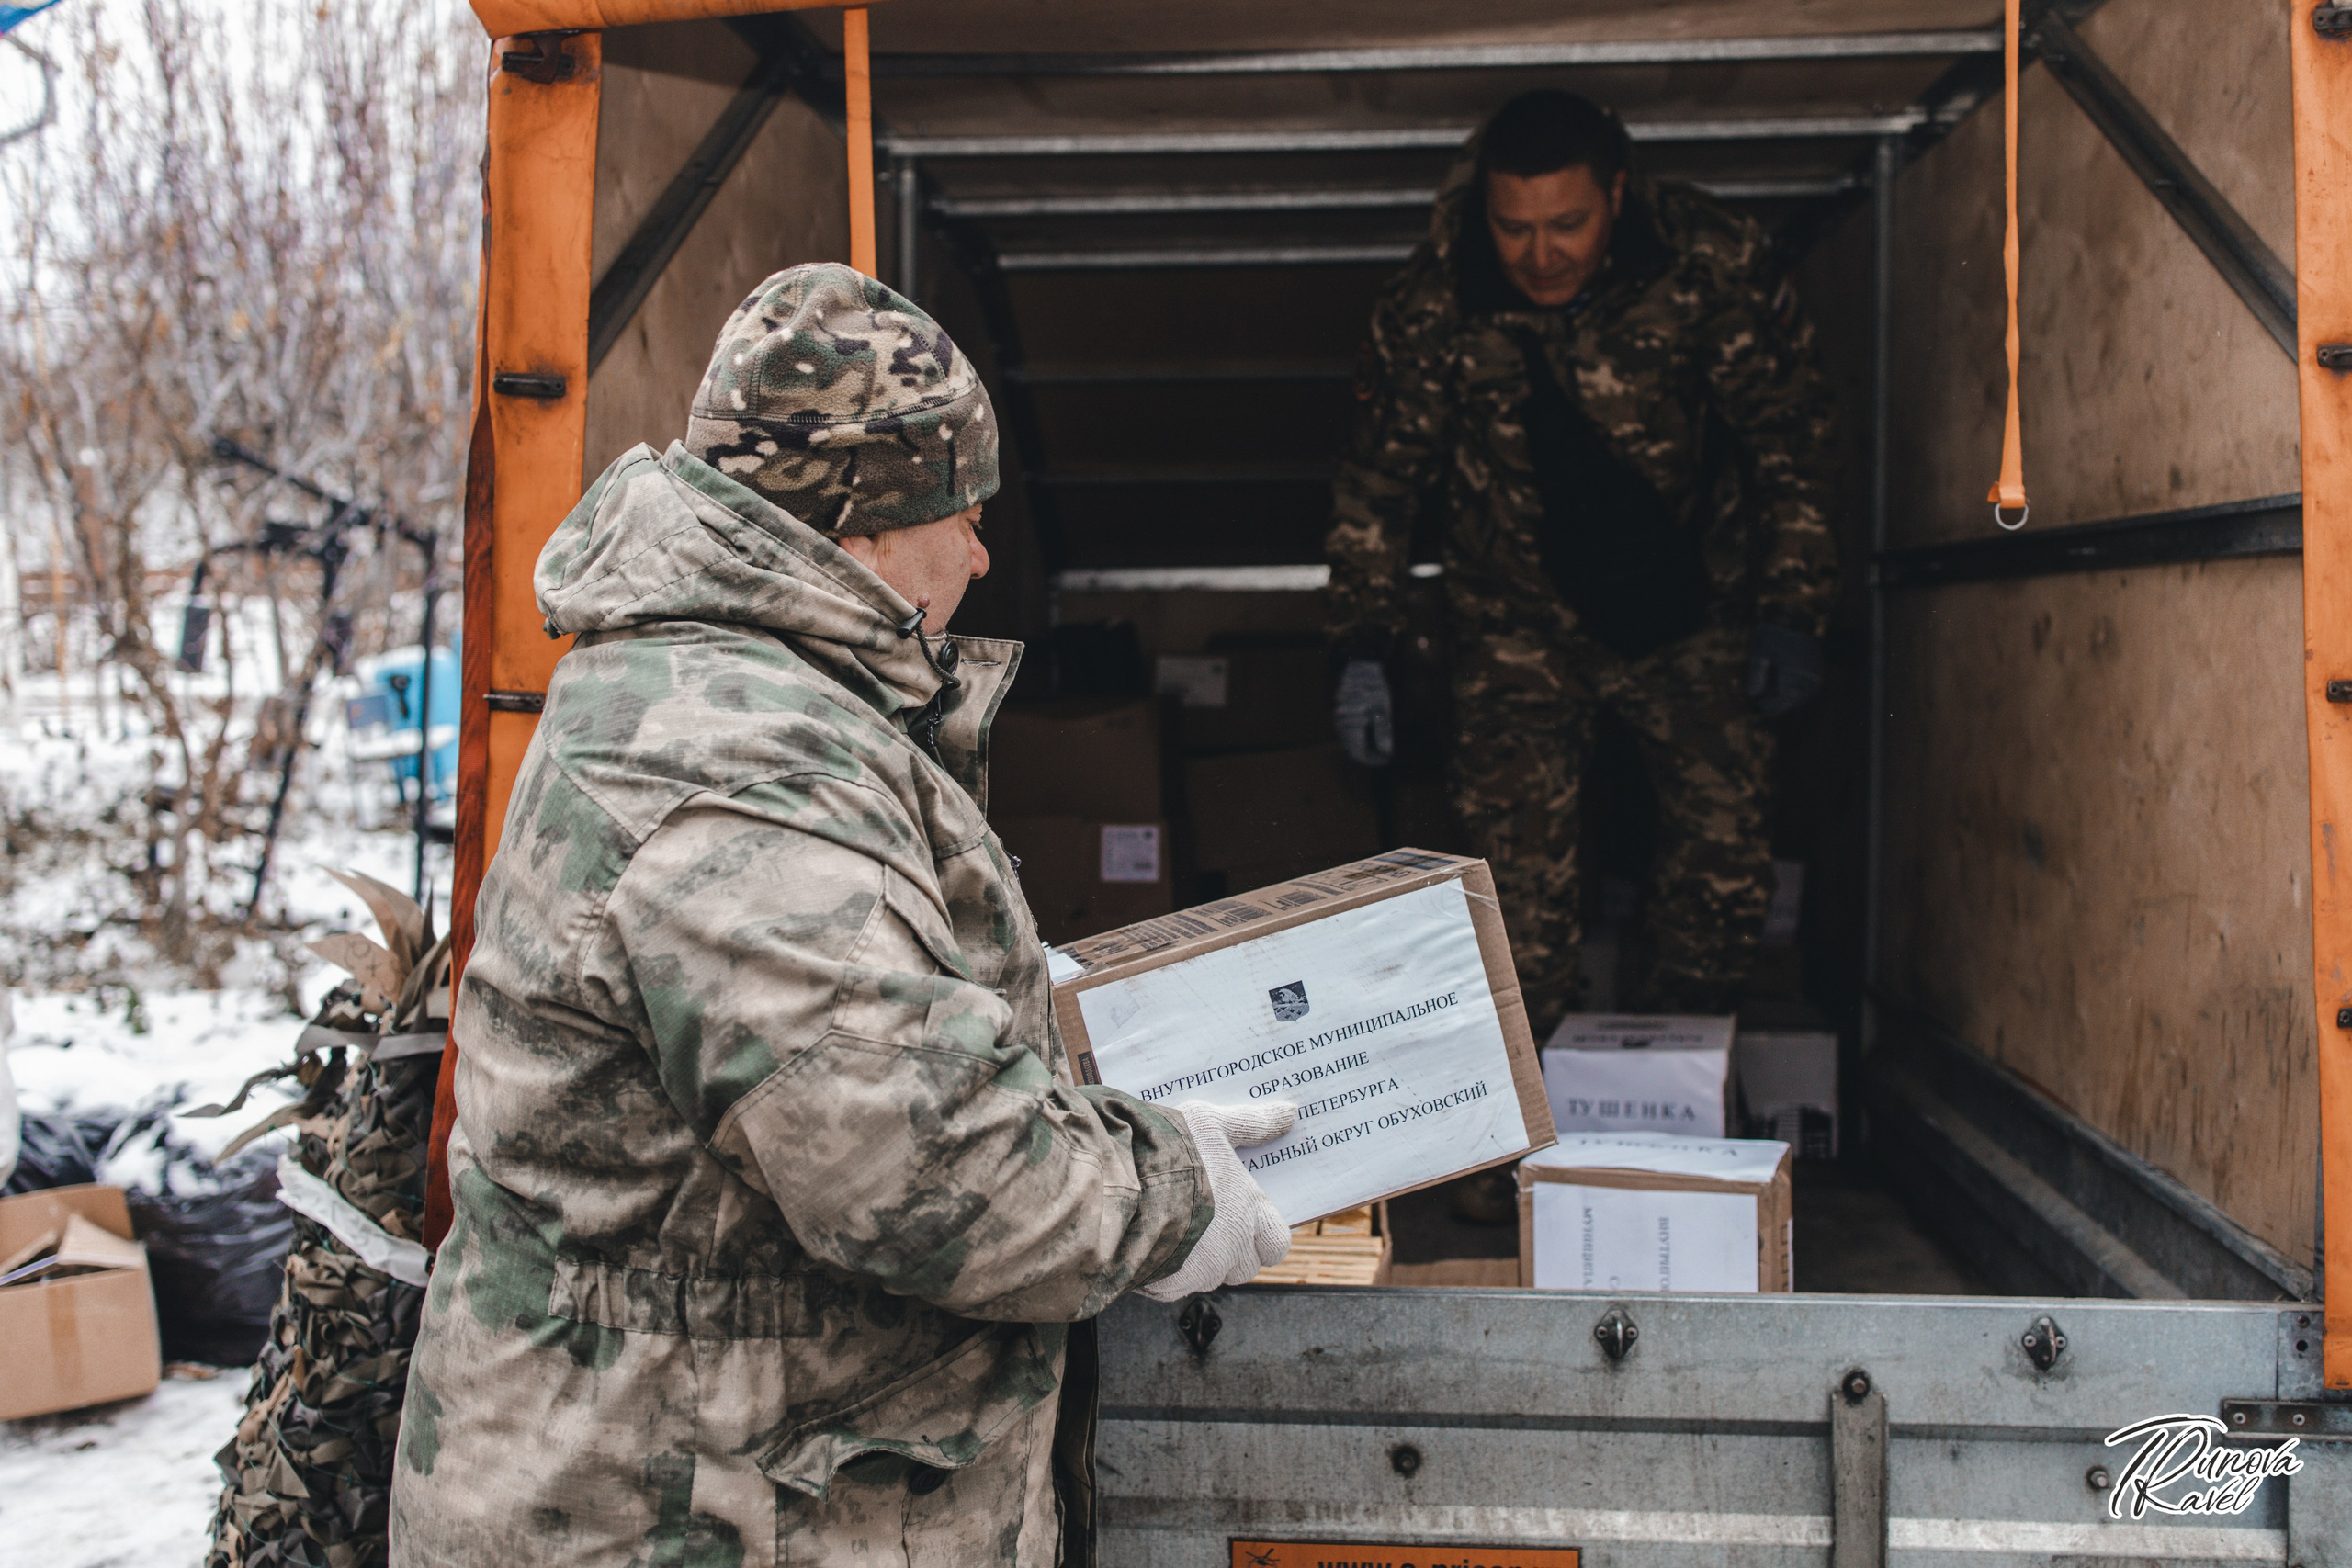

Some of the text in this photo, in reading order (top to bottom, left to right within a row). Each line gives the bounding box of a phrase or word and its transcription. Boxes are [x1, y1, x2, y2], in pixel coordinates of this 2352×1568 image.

[1140, 992, 1459, 1102] ВНУТРИГОРОДСКОЕ МУНИЦИПАЛЬНОЕ
[1250, 1051, 1370, 1099] ОБРАЗОВАНИЕ
[1242, 1080, 1487, 1173] АЛЬНЫЙ ОКРУГ ОБУХОВСКИЙ
[1569, 1098, 1695, 1121] ТУШЕНКА
[1582, 1206, 1594, 1290] МУНИЦИПА
